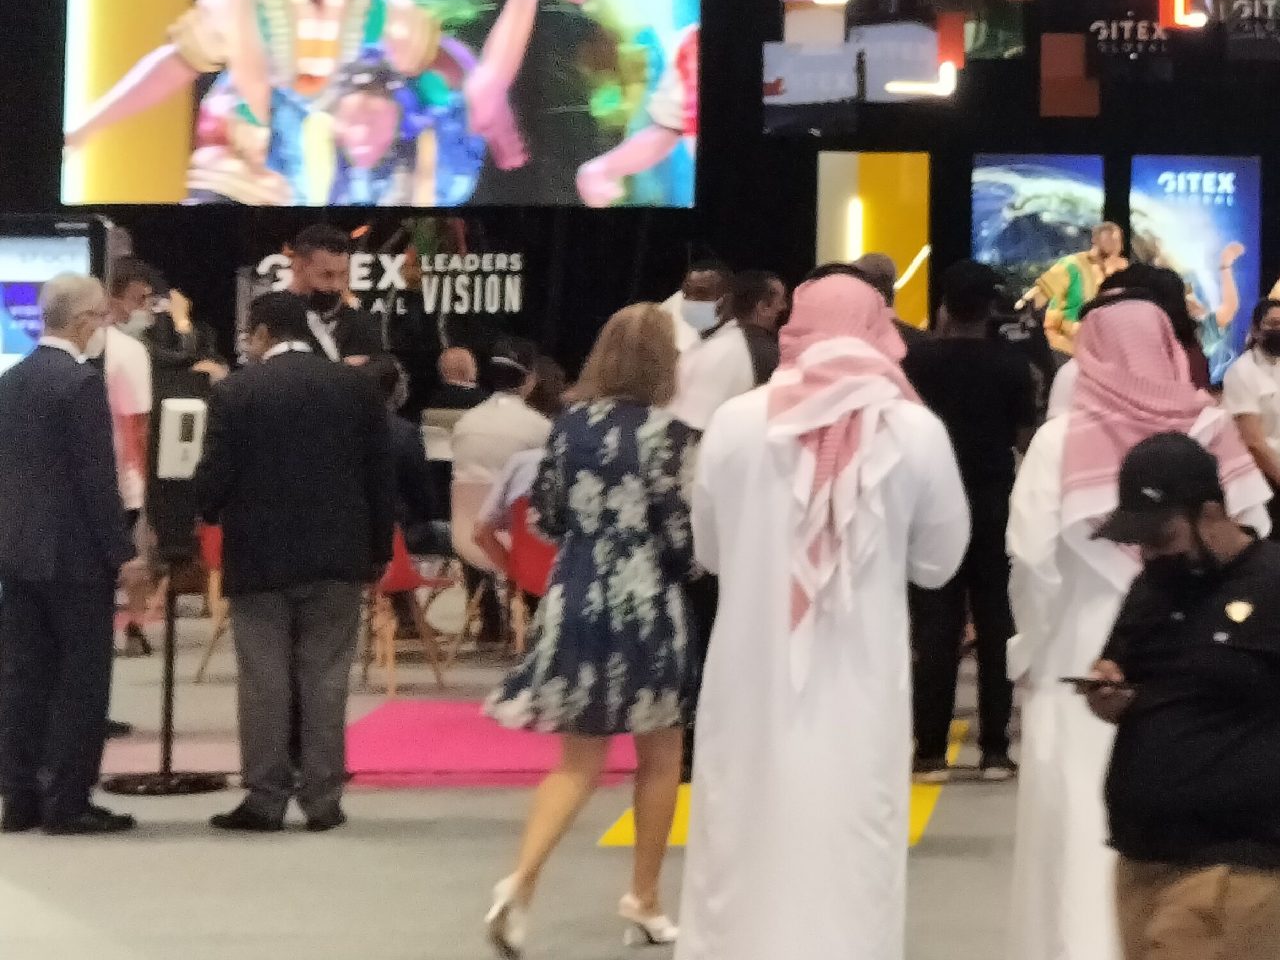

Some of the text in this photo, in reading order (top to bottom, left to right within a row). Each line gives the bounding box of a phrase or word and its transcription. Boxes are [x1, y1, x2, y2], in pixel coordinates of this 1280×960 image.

[1089, 19, 1168, 41] GITEX
[1157, 171, 1236, 194] GITEX
[257, 253, 408, 291] GEX
[420, 253, 523, 272] LEADERS
[420, 274, 522, 314] VISION
